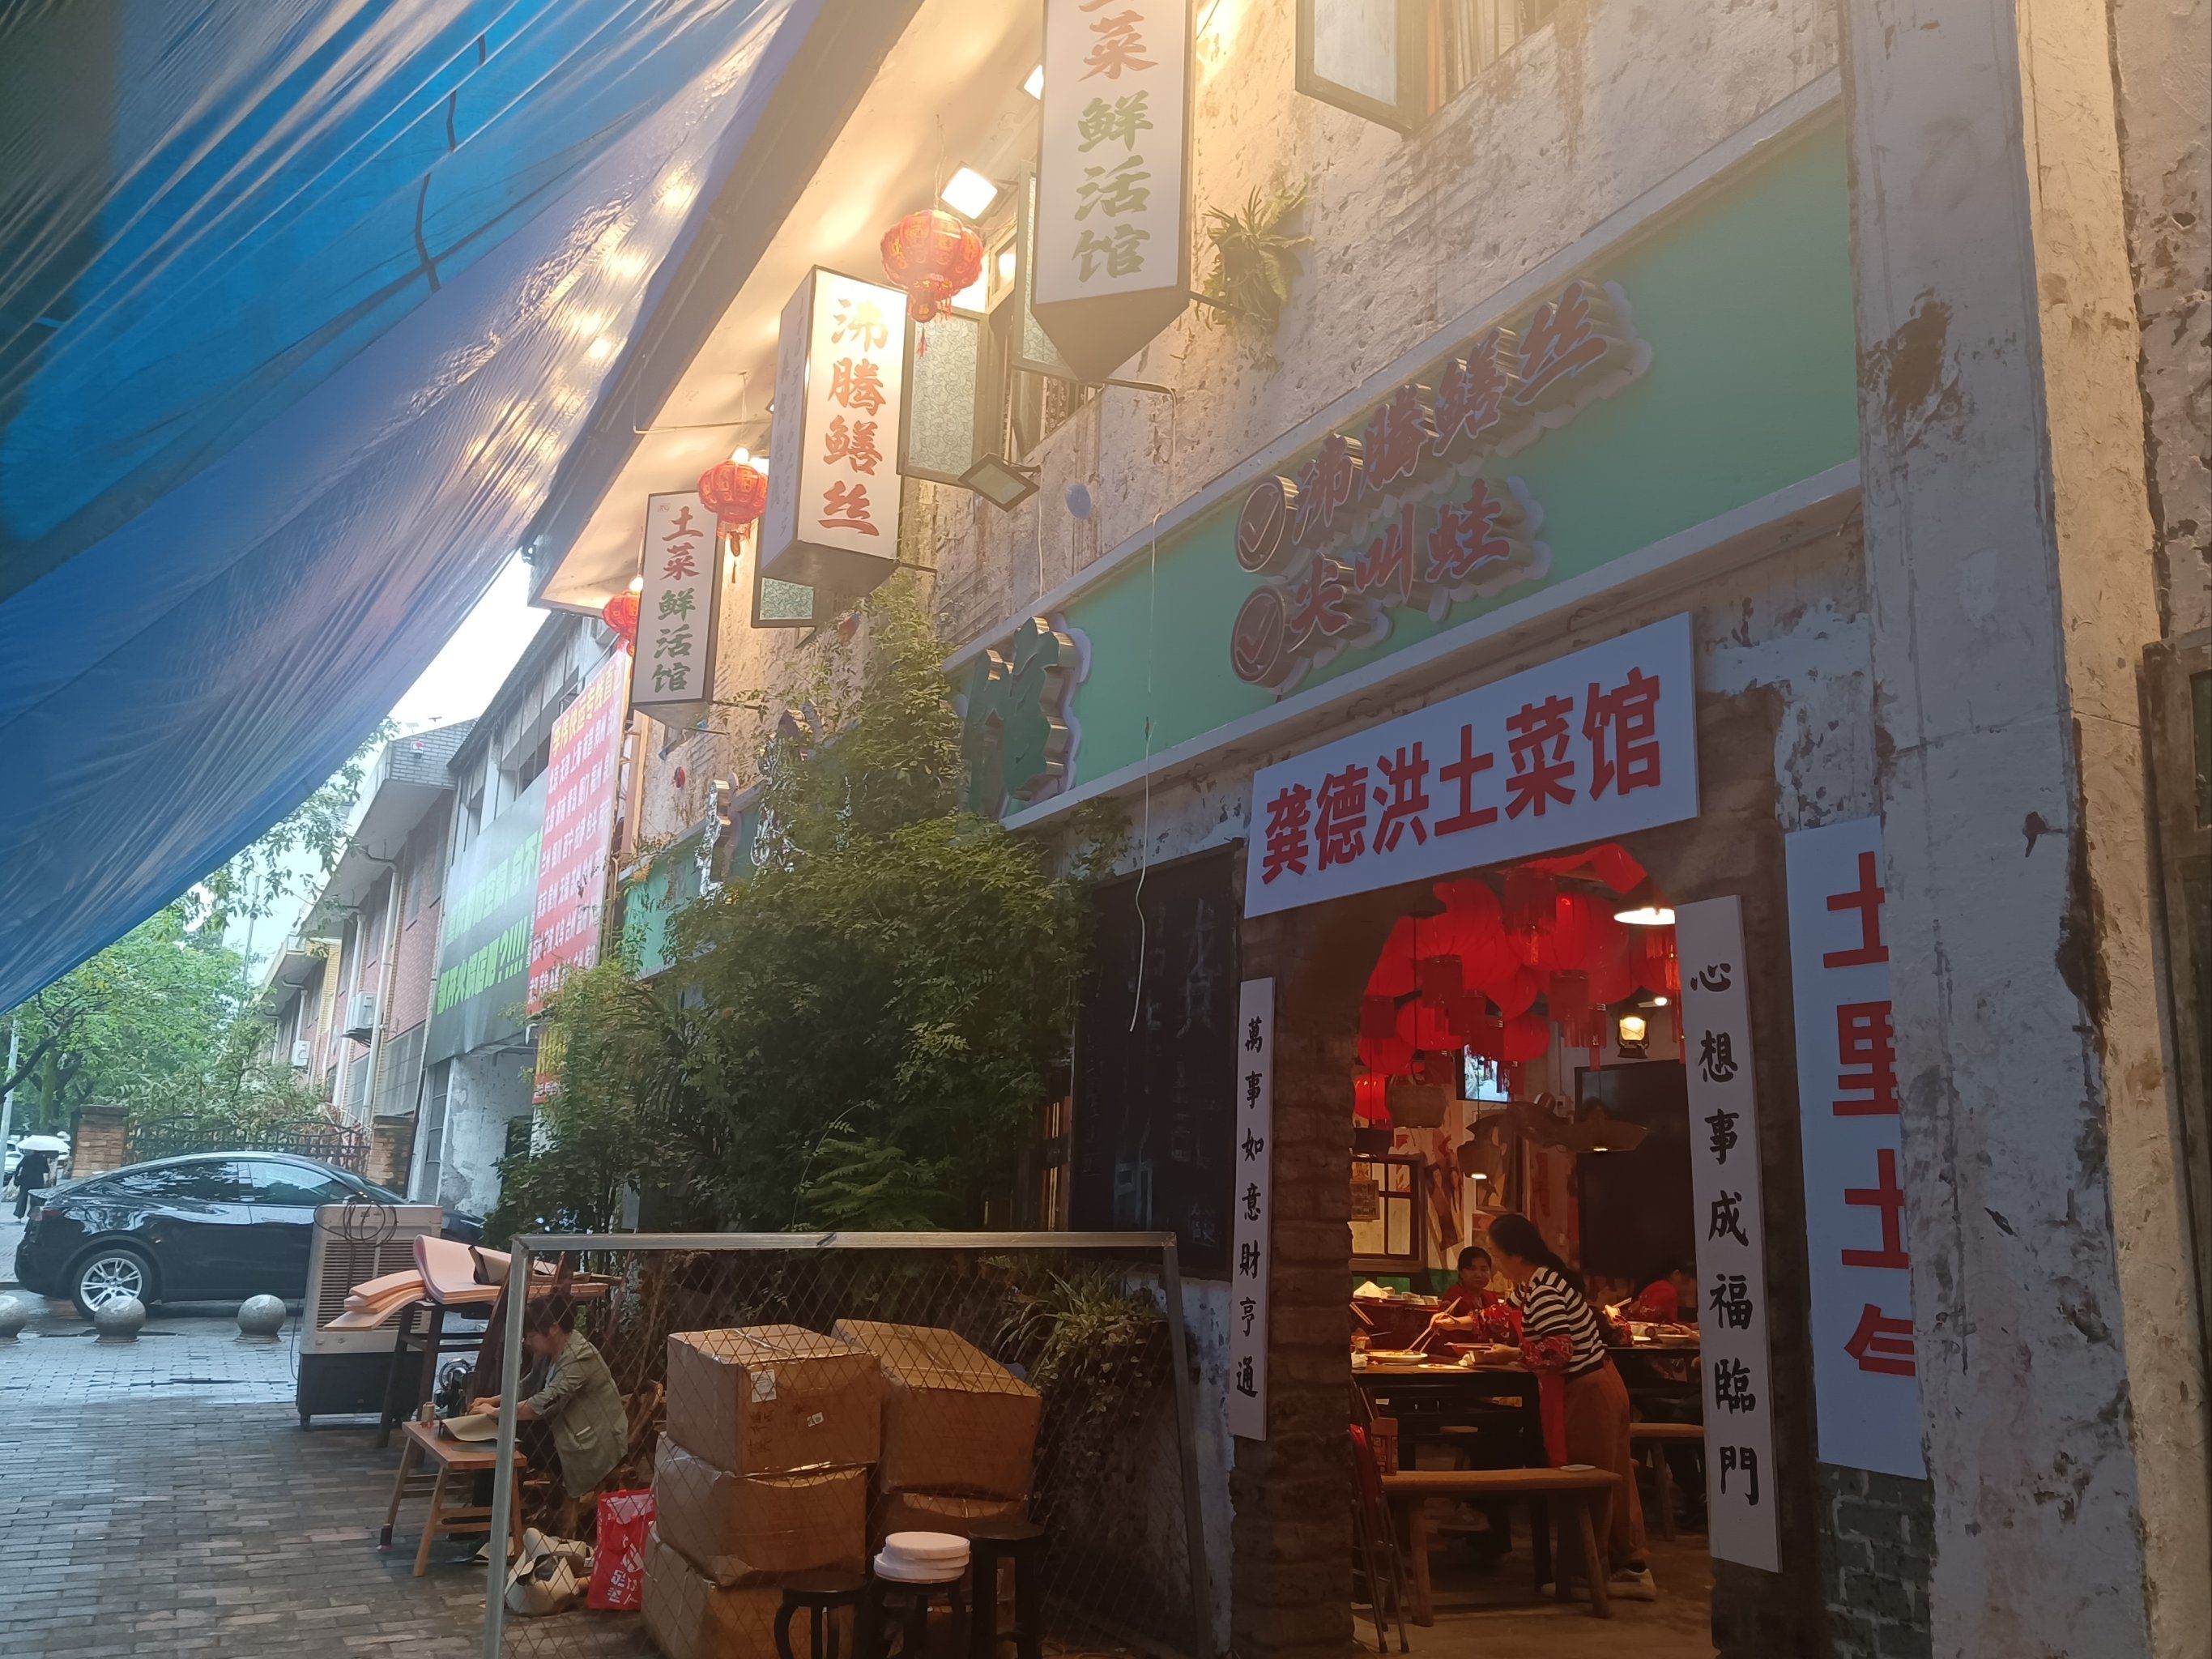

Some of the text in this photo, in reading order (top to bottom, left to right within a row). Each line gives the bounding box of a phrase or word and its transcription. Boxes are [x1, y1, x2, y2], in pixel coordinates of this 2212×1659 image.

[1072, 0, 1158, 282] 菜鲜活馆
[818, 297, 888, 536] 沸腾鳝丝
[651, 506, 704, 693] 土菜鲜活馆
[1261, 666, 1661, 885] 龚德洪土菜馆
[1236, 1016, 1264, 1398] 萬事如意財亨通
[1690, 962, 1760, 1506] 心想事成福臨門
